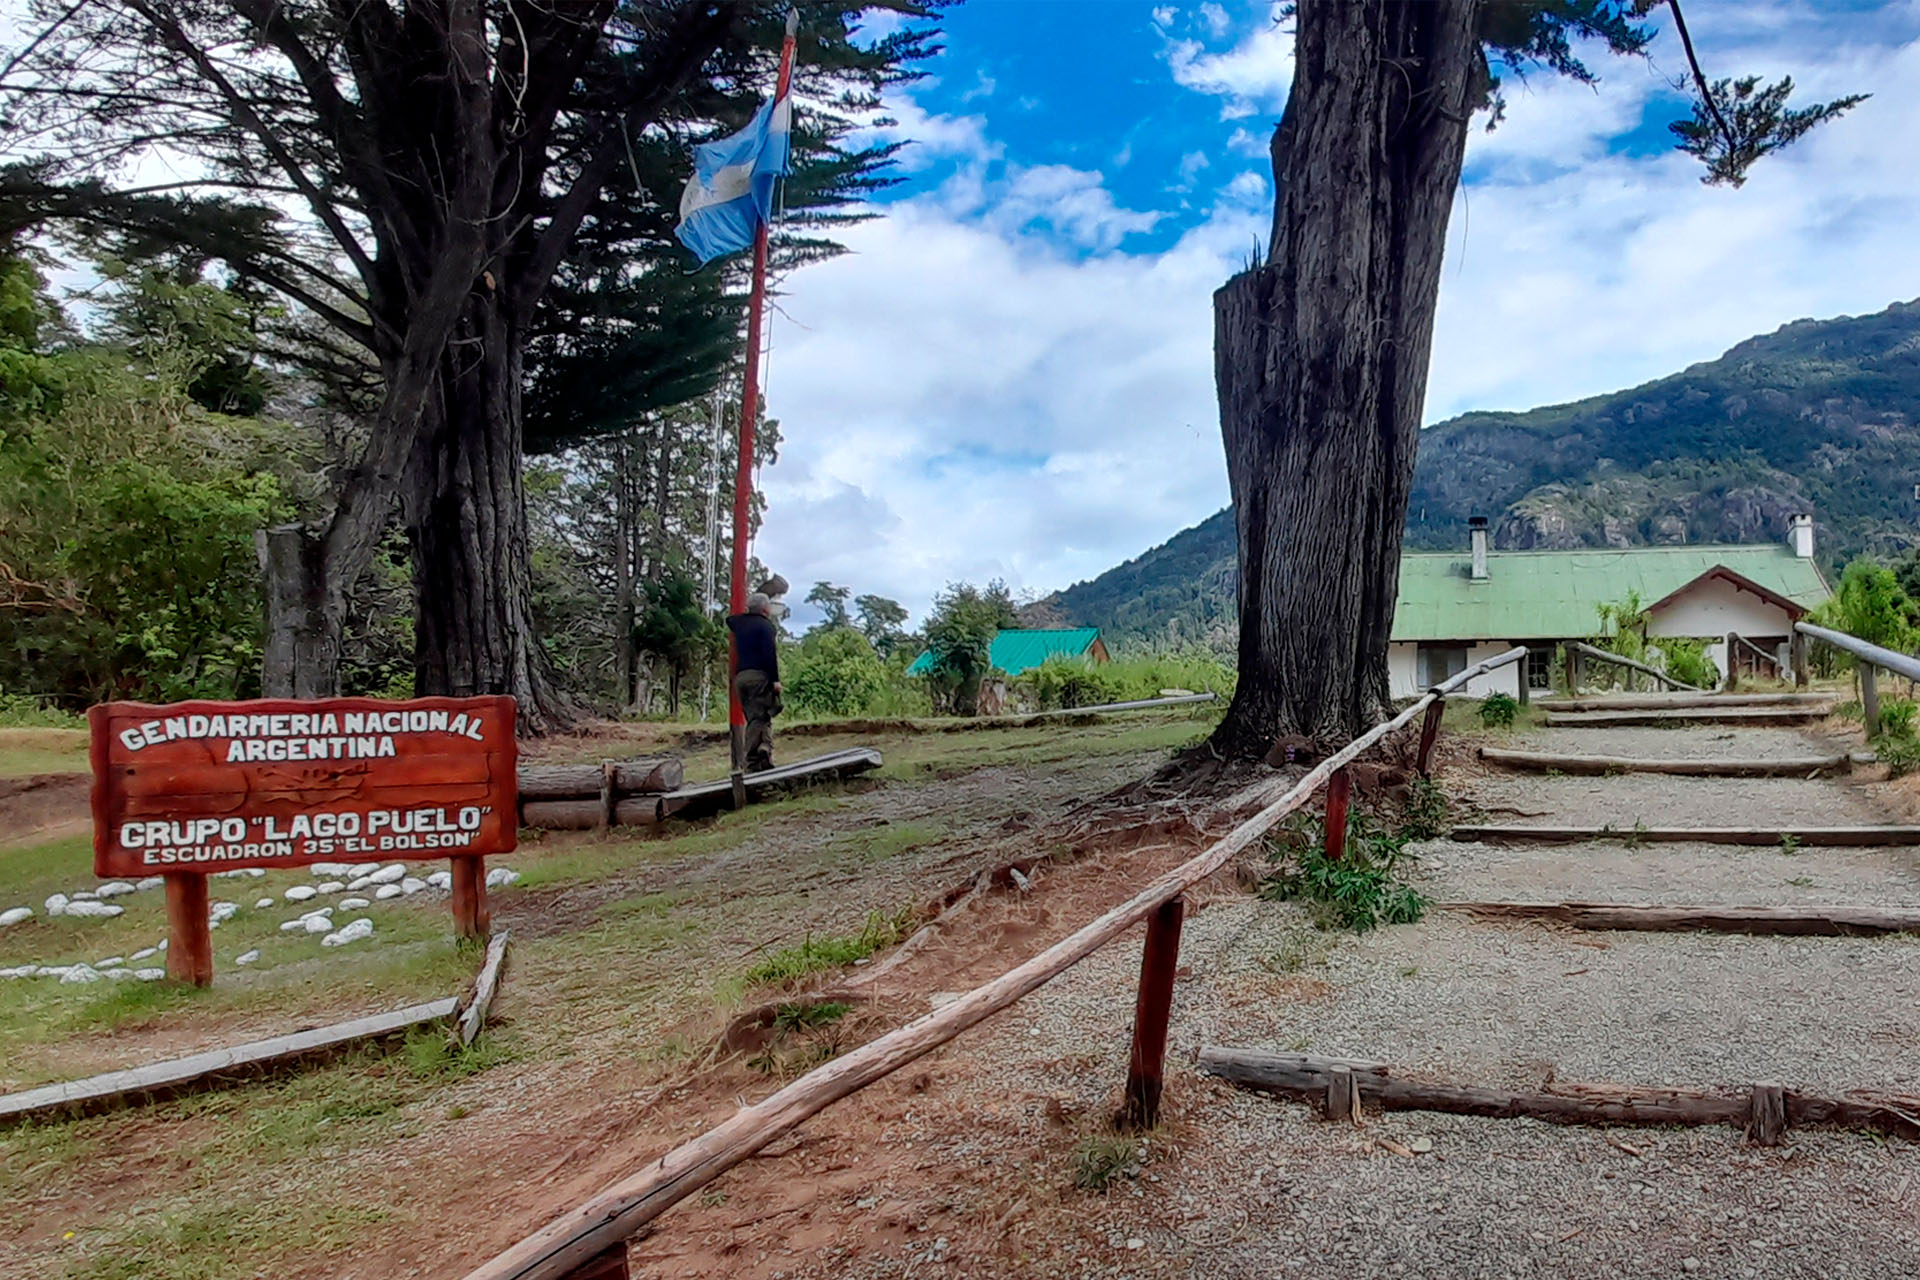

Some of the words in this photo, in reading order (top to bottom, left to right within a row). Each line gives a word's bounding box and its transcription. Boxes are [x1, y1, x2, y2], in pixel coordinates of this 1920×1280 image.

[118, 713, 340, 752] GENDARMERIA
[344, 710, 484, 741] NACIONAL
[226, 736, 396, 762] ARGENTINA
[119, 817, 246, 848] GRUPO
[143, 841, 292, 864] ESCUADRON
